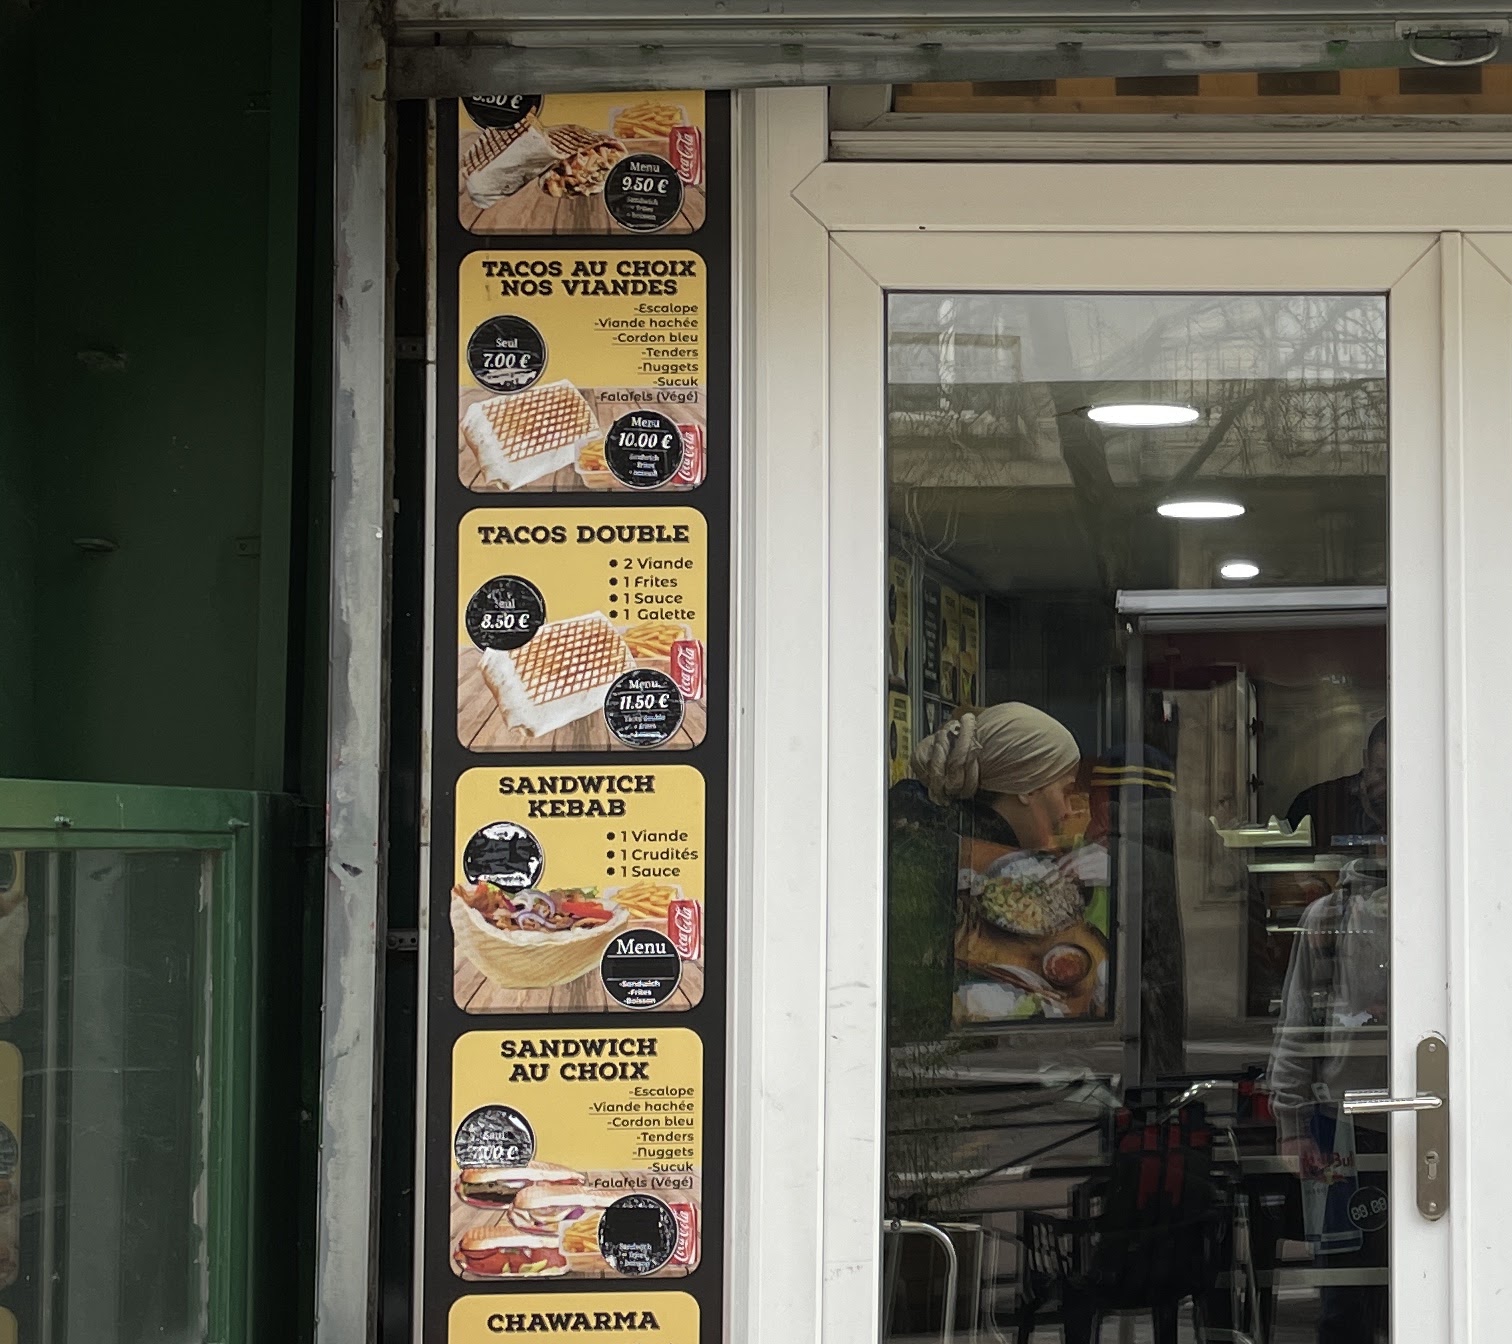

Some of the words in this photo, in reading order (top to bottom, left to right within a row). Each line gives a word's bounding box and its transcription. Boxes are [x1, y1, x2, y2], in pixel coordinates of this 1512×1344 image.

[630, 161, 660, 173] Menu
[658, 179, 669, 194] €
[482, 260, 562, 278] TACOS
[571, 260, 608, 277] AU
[616, 260, 697, 278] CHOIX
[501, 279, 553, 296] NOS
[561, 279, 678, 296] VIANDES
[650, 318, 699, 328] hachée
[496, 338, 518, 348] Seul
[669, 332, 699, 343] bleu
[483, 353, 516, 368] 7.00
[520, 354, 531, 368] €
[656, 391, 699, 403] (Végé)
[631, 417, 660, 428] Menu
[618, 432, 658, 448] 10.00
[662, 434, 673, 449] €
[478, 525, 567, 544] TACOS
[576, 524, 690, 544] DOUBLE
[623, 558, 633, 570] 2
[636, 557, 694, 570] Viande
[481, 614, 515, 629] 8.50
[518, 613, 530, 628] €
[624, 609, 629, 620] 1
[637, 608, 696, 621] Galette
[620, 694, 655, 710] 11.50
[659, 693, 669, 708] €
[499, 774, 656, 795] SANDWICH
[528, 798, 627, 818] KEBAB
[621, 830, 627, 842] 1
[632, 829, 688, 842] Viande
[621, 849, 627, 860] 1
[631, 848, 699, 861] Crudités
[616, 938, 666, 954] Menu
[501, 1037, 658, 1058] SANDWICH
[509, 1063, 550, 1082] AU
[560, 1061, 650, 1082] CHOIX
[644, 1101, 695, 1112] hachée
[665, 1116, 695, 1127] bleu
[651, 1177, 694, 1189] (Végé)
[487, 1311, 661, 1333] CHAWARMA
